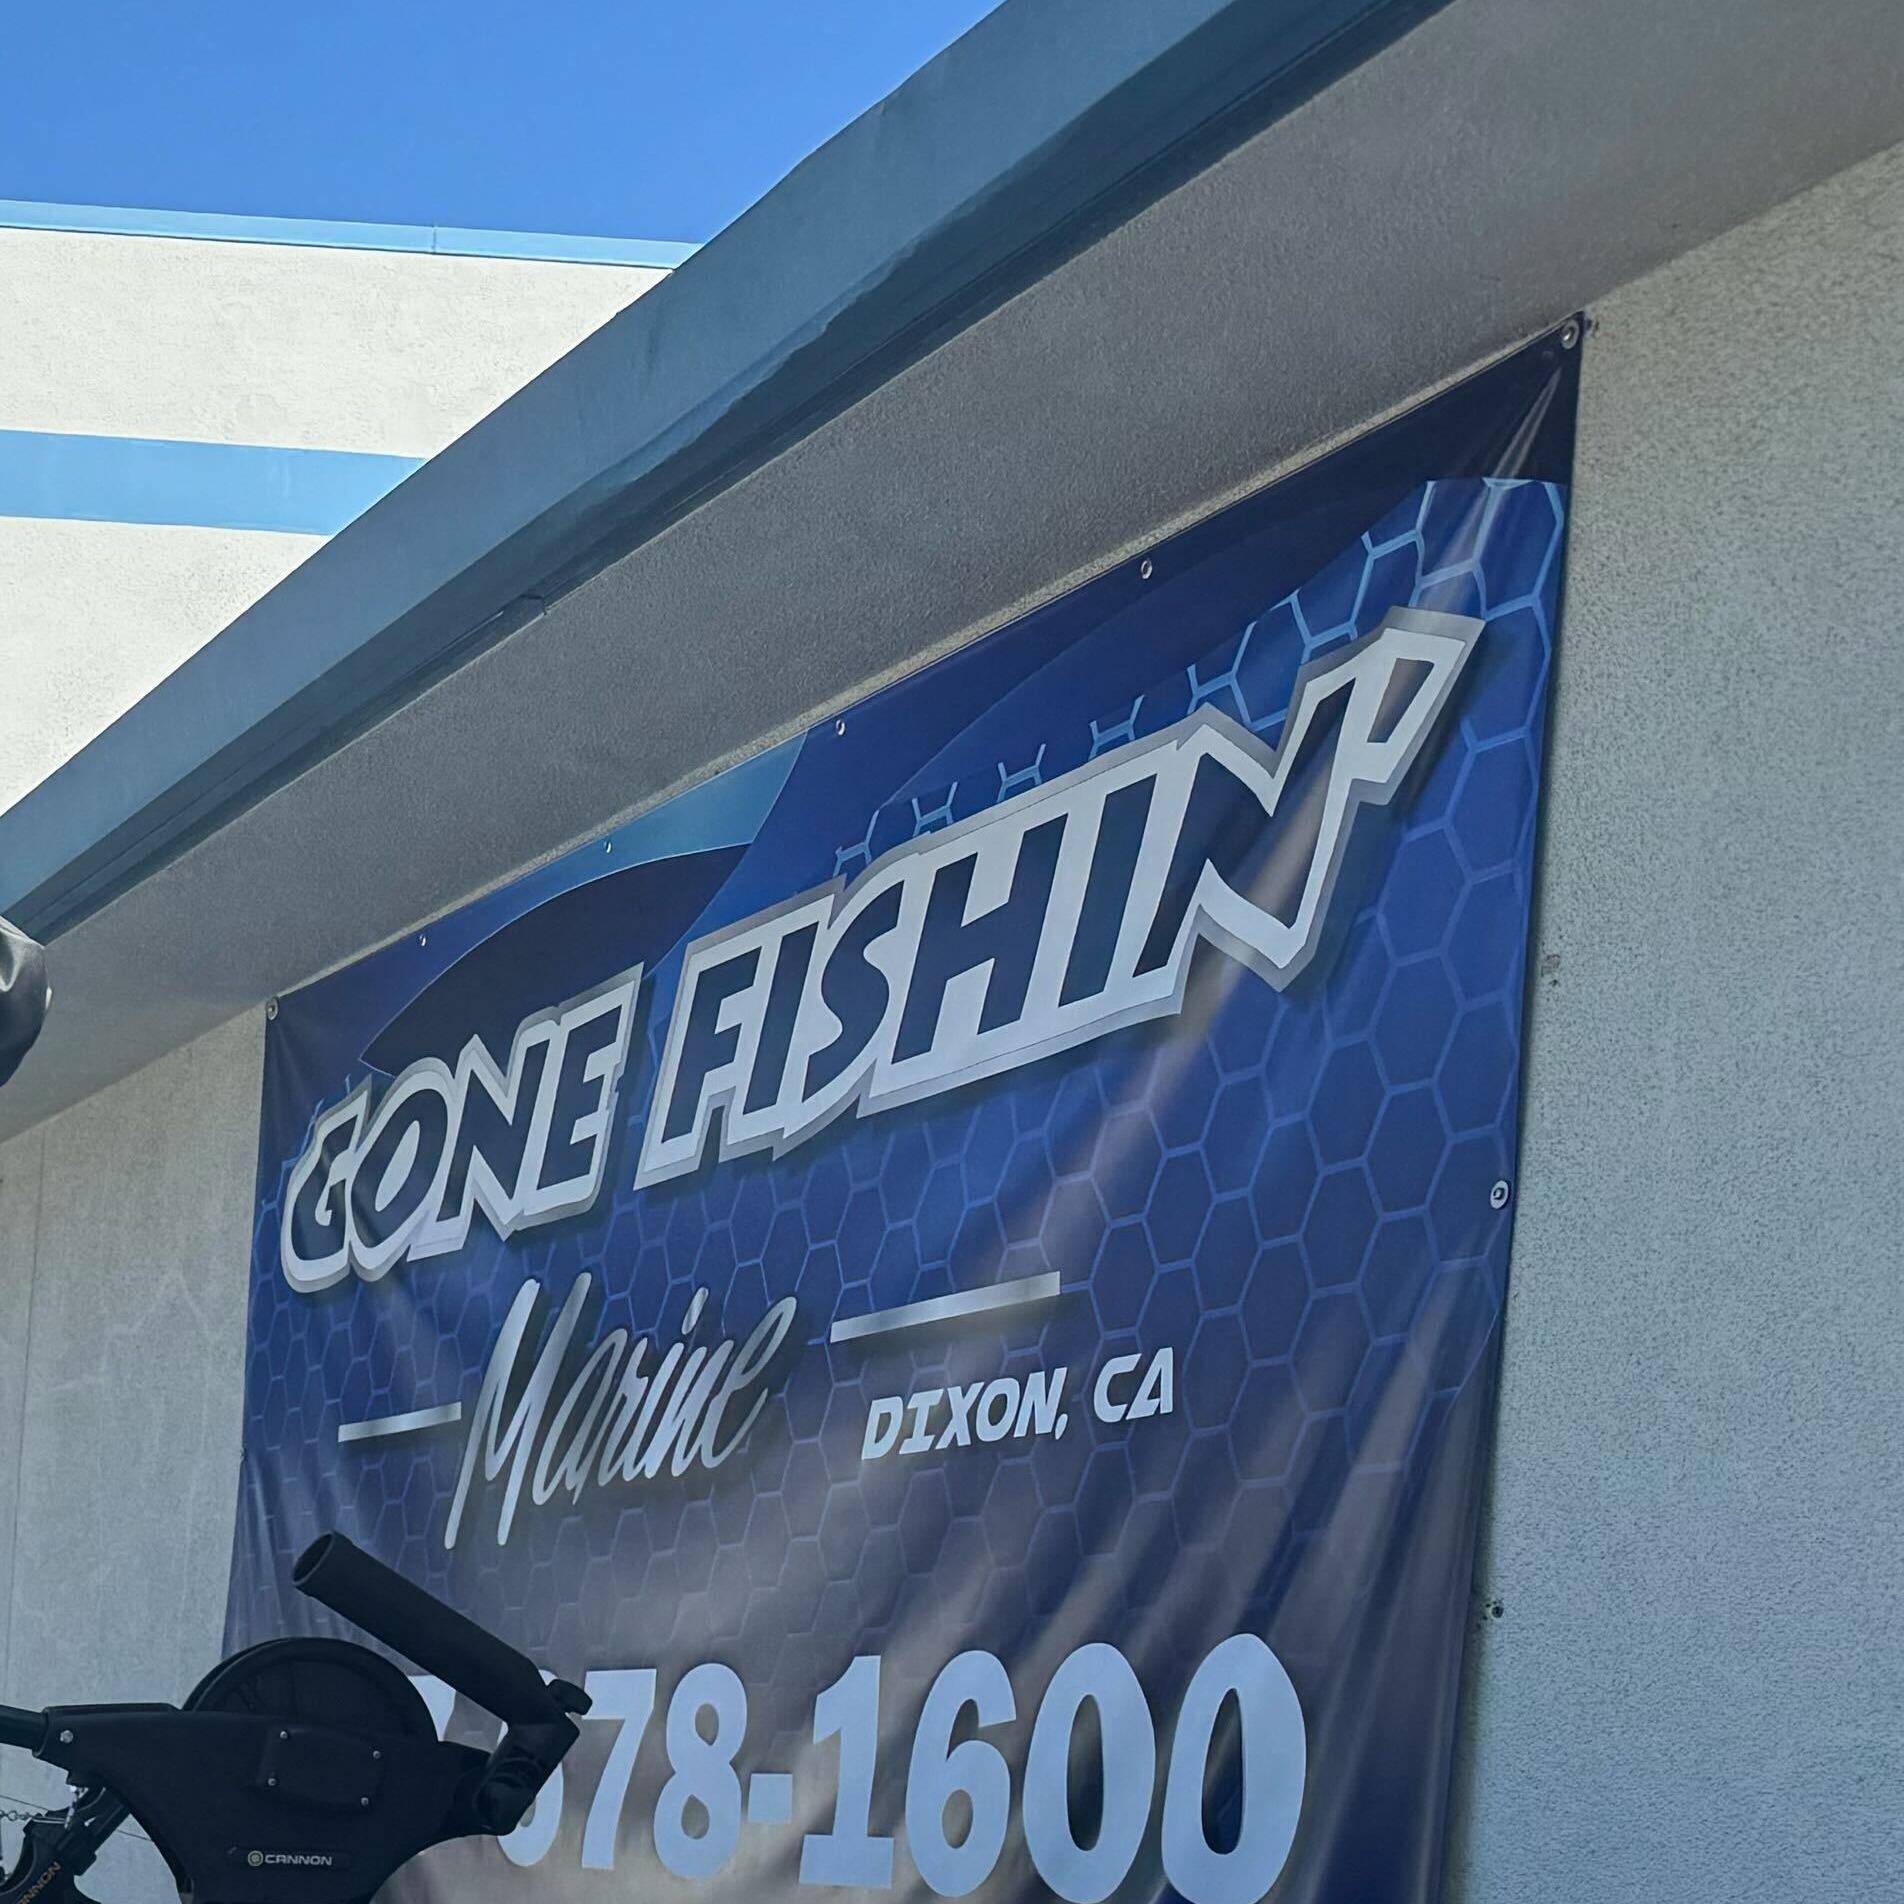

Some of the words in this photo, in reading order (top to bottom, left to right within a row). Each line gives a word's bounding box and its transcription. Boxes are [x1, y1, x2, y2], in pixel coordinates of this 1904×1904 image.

[283, 966, 643, 1292] GONE
[636, 612, 1482, 1188] FISHIN'
[443, 1271, 797, 1550] Marine
[860, 1367, 1069, 1461] DIXON,
[1093, 1346, 1176, 1423] CA
[265, 1854, 332, 1866] CANNON
